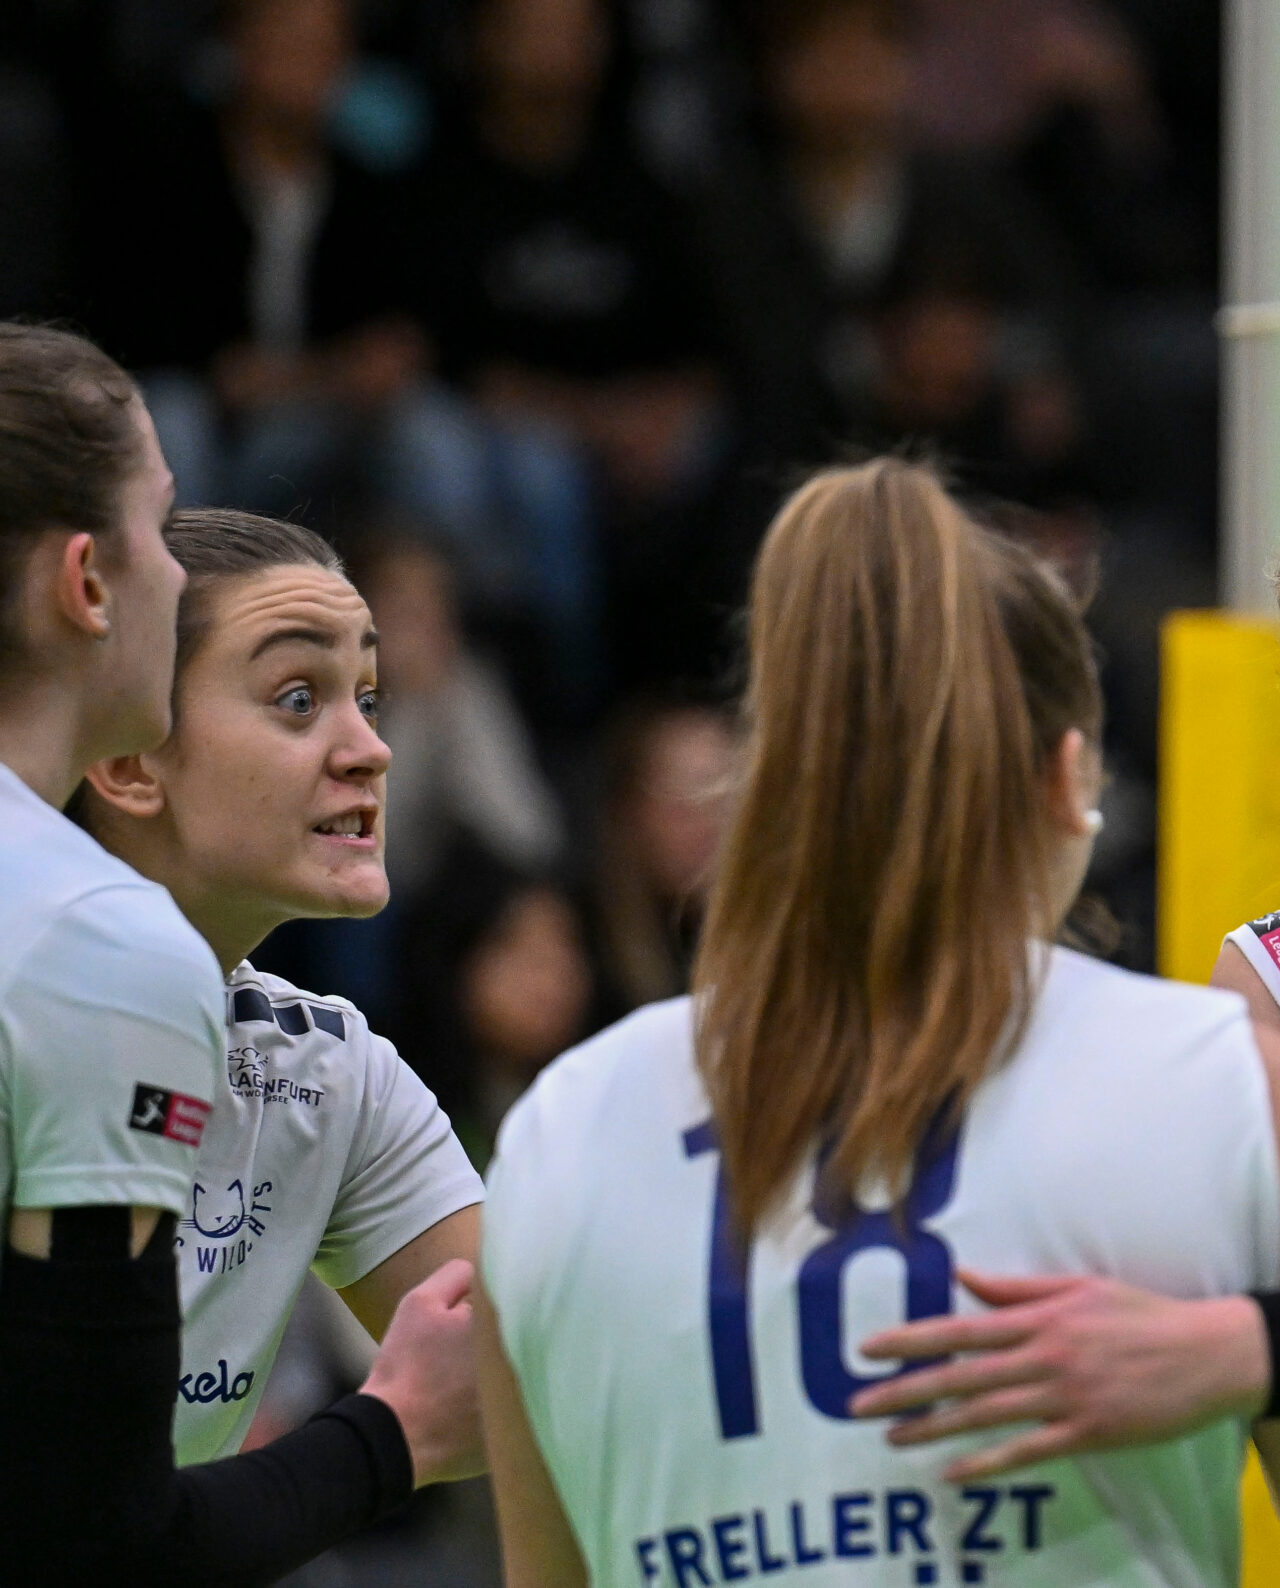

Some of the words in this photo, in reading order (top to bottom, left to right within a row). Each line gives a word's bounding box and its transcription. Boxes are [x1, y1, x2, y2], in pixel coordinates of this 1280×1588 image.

[228, 1071, 325, 1106] LAGNFURT
[681, 1080, 967, 1442] 18
[958, 1484, 1056, 1552] ZT
